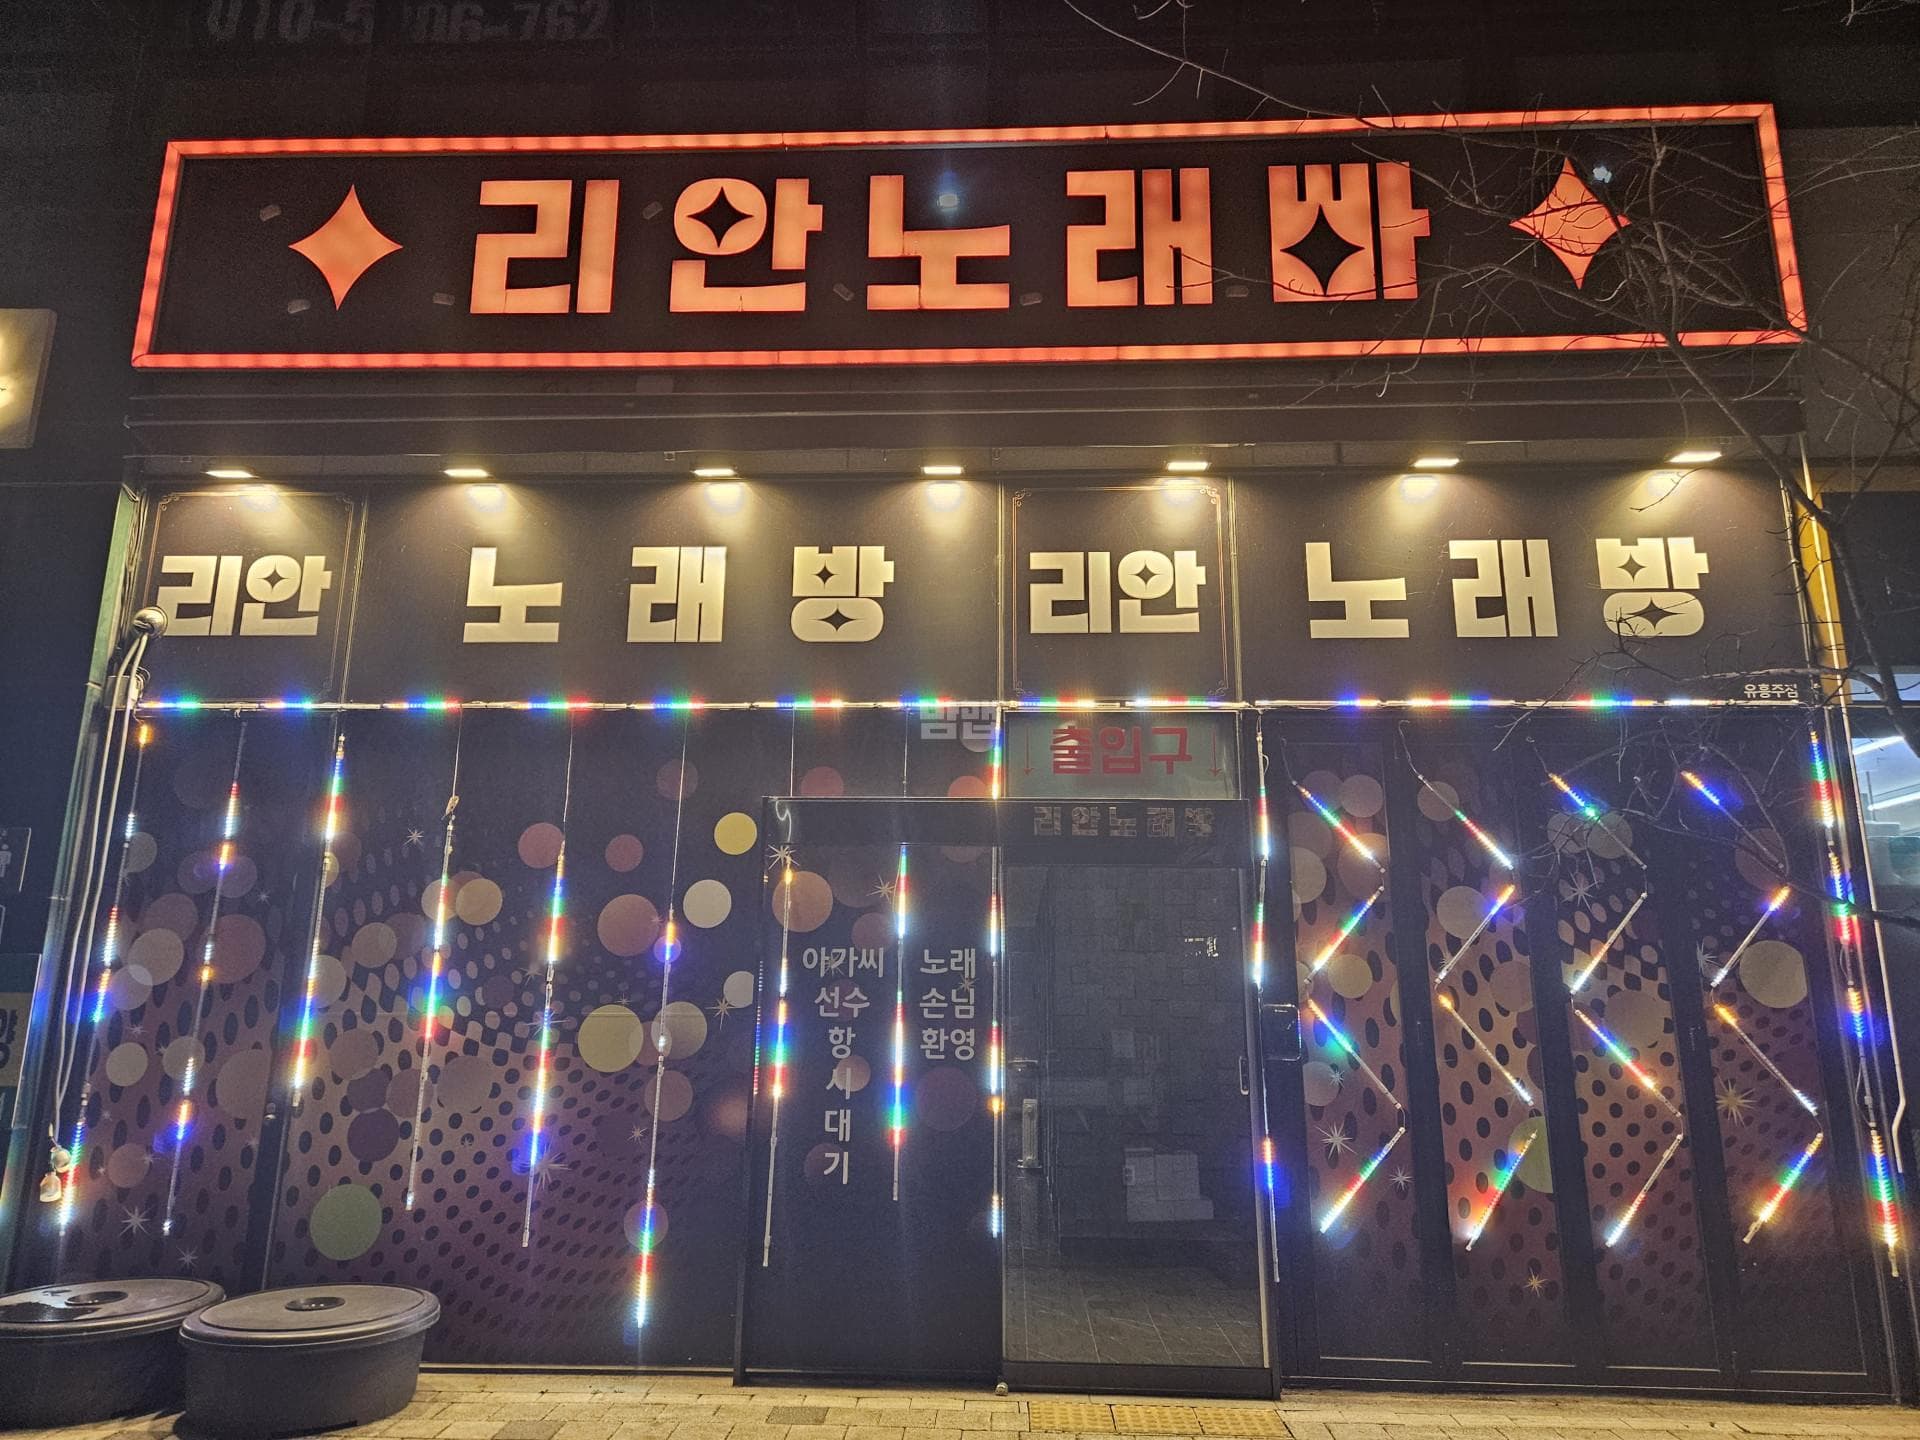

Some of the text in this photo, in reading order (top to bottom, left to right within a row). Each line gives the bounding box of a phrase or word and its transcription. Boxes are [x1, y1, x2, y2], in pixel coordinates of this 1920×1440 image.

[157, 554, 332, 636] 리안
[1029, 550, 1206, 634] 리안
[1052, 725, 1193, 775] 출입구
[802, 947, 884, 979] 아가씨
[919, 948, 977, 979] 노래
[814, 987, 871, 1019] 선수
[919, 987, 976, 1020] 손님
[919, 1028, 976, 1061] 환영
